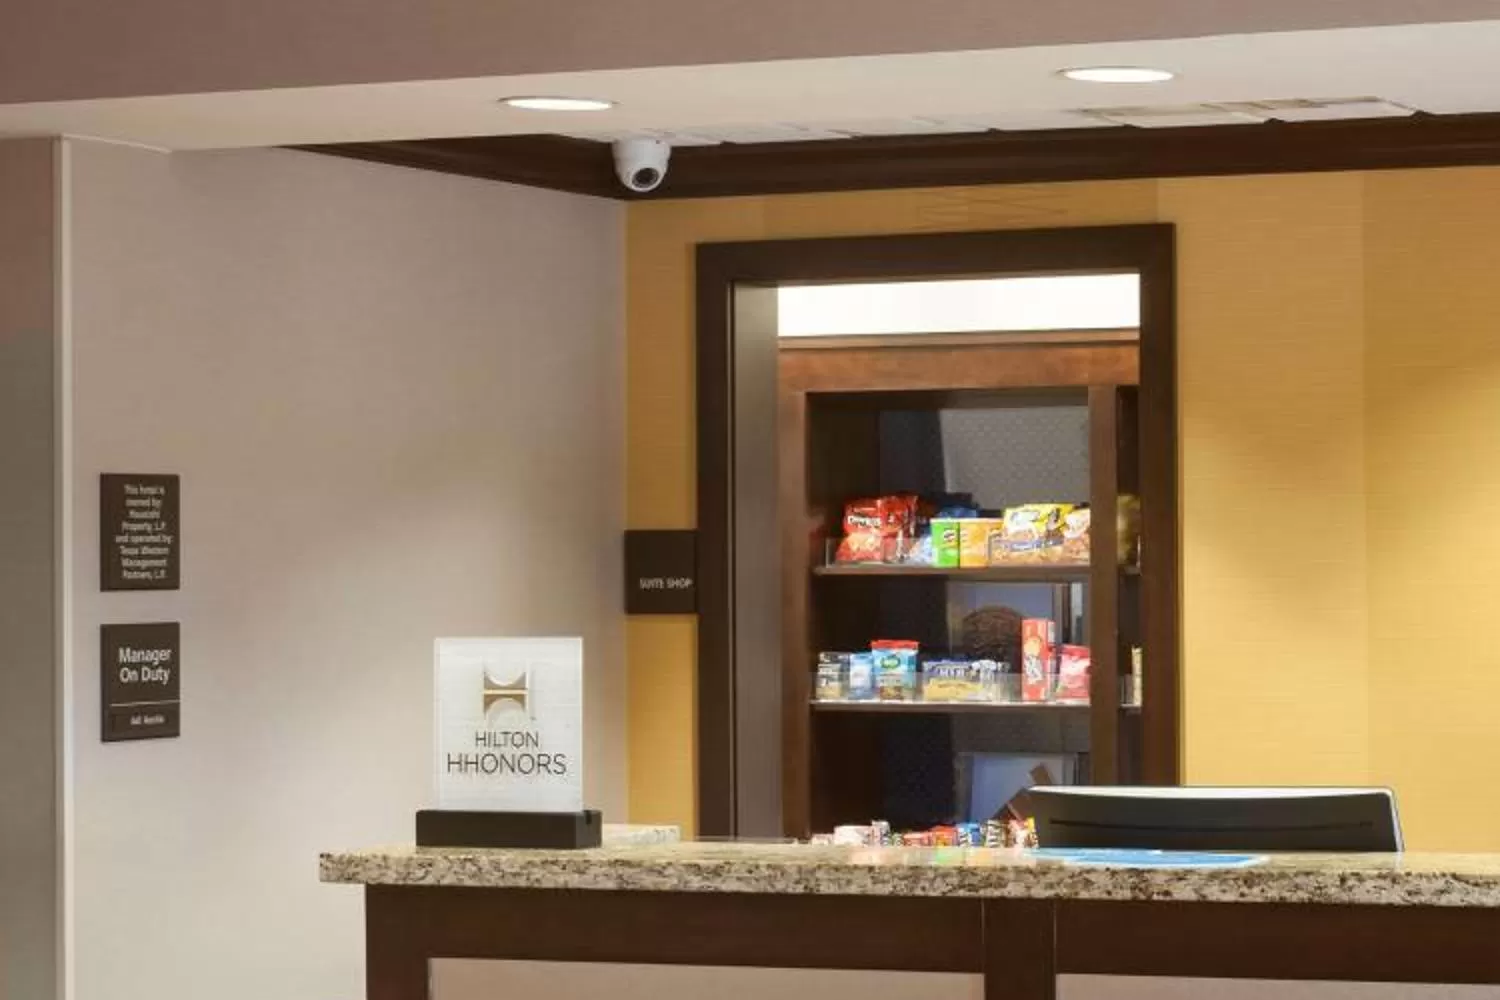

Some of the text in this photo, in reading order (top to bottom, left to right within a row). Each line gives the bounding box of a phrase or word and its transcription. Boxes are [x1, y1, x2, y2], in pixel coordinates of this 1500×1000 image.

[639, 577, 693, 589] SUITE SHOP
[118, 646, 172, 666] Manager
[119, 665, 171, 686] On Duty
[475, 731, 540, 749] HILTON
[447, 753, 567, 775] HHONORS
